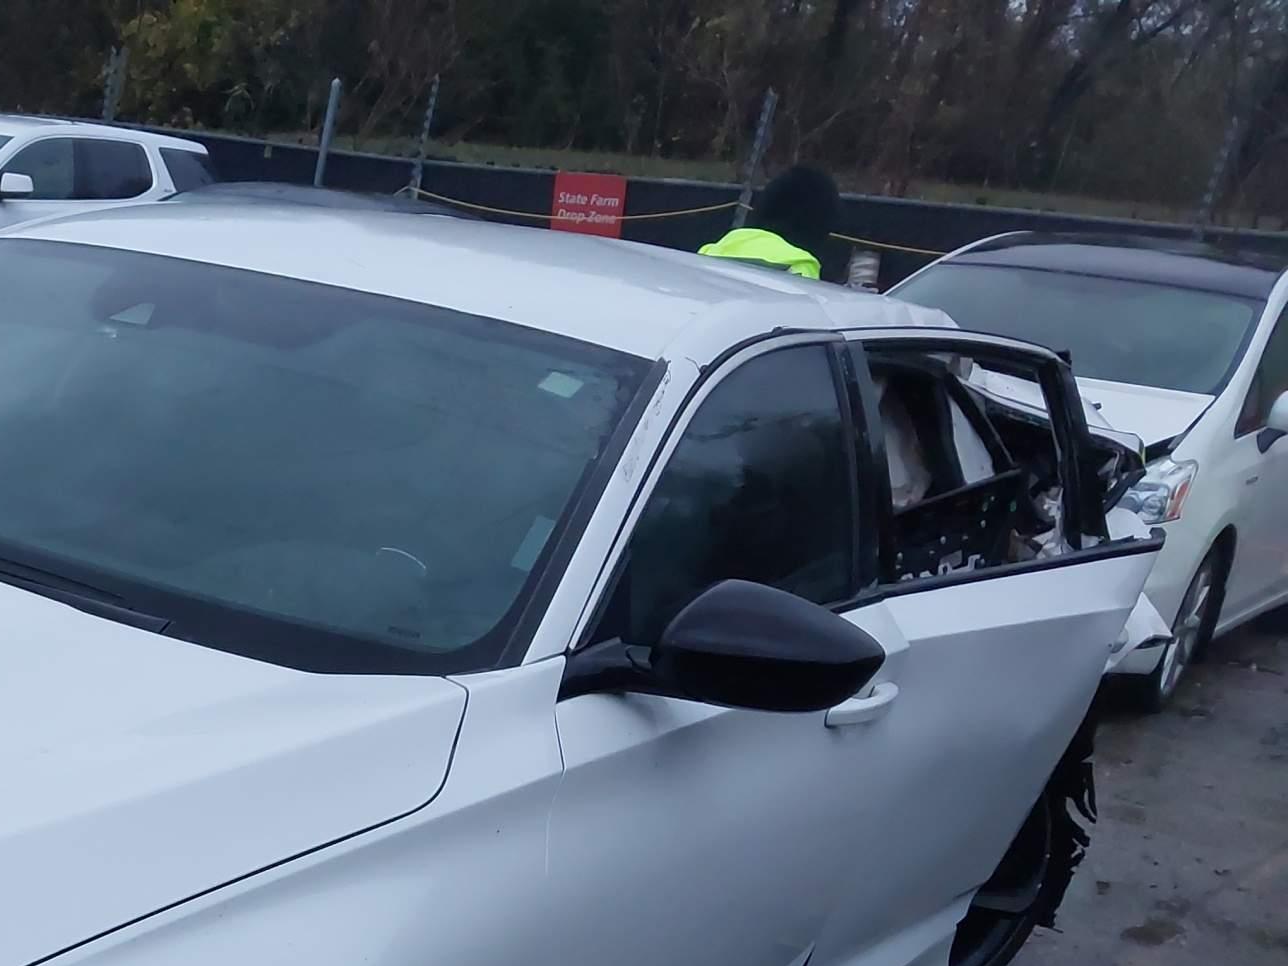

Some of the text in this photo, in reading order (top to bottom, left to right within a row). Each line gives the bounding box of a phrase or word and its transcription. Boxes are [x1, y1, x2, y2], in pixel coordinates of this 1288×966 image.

[558, 191, 619, 207] State Farm
[557, 208, 617, 224] Drop Zone
